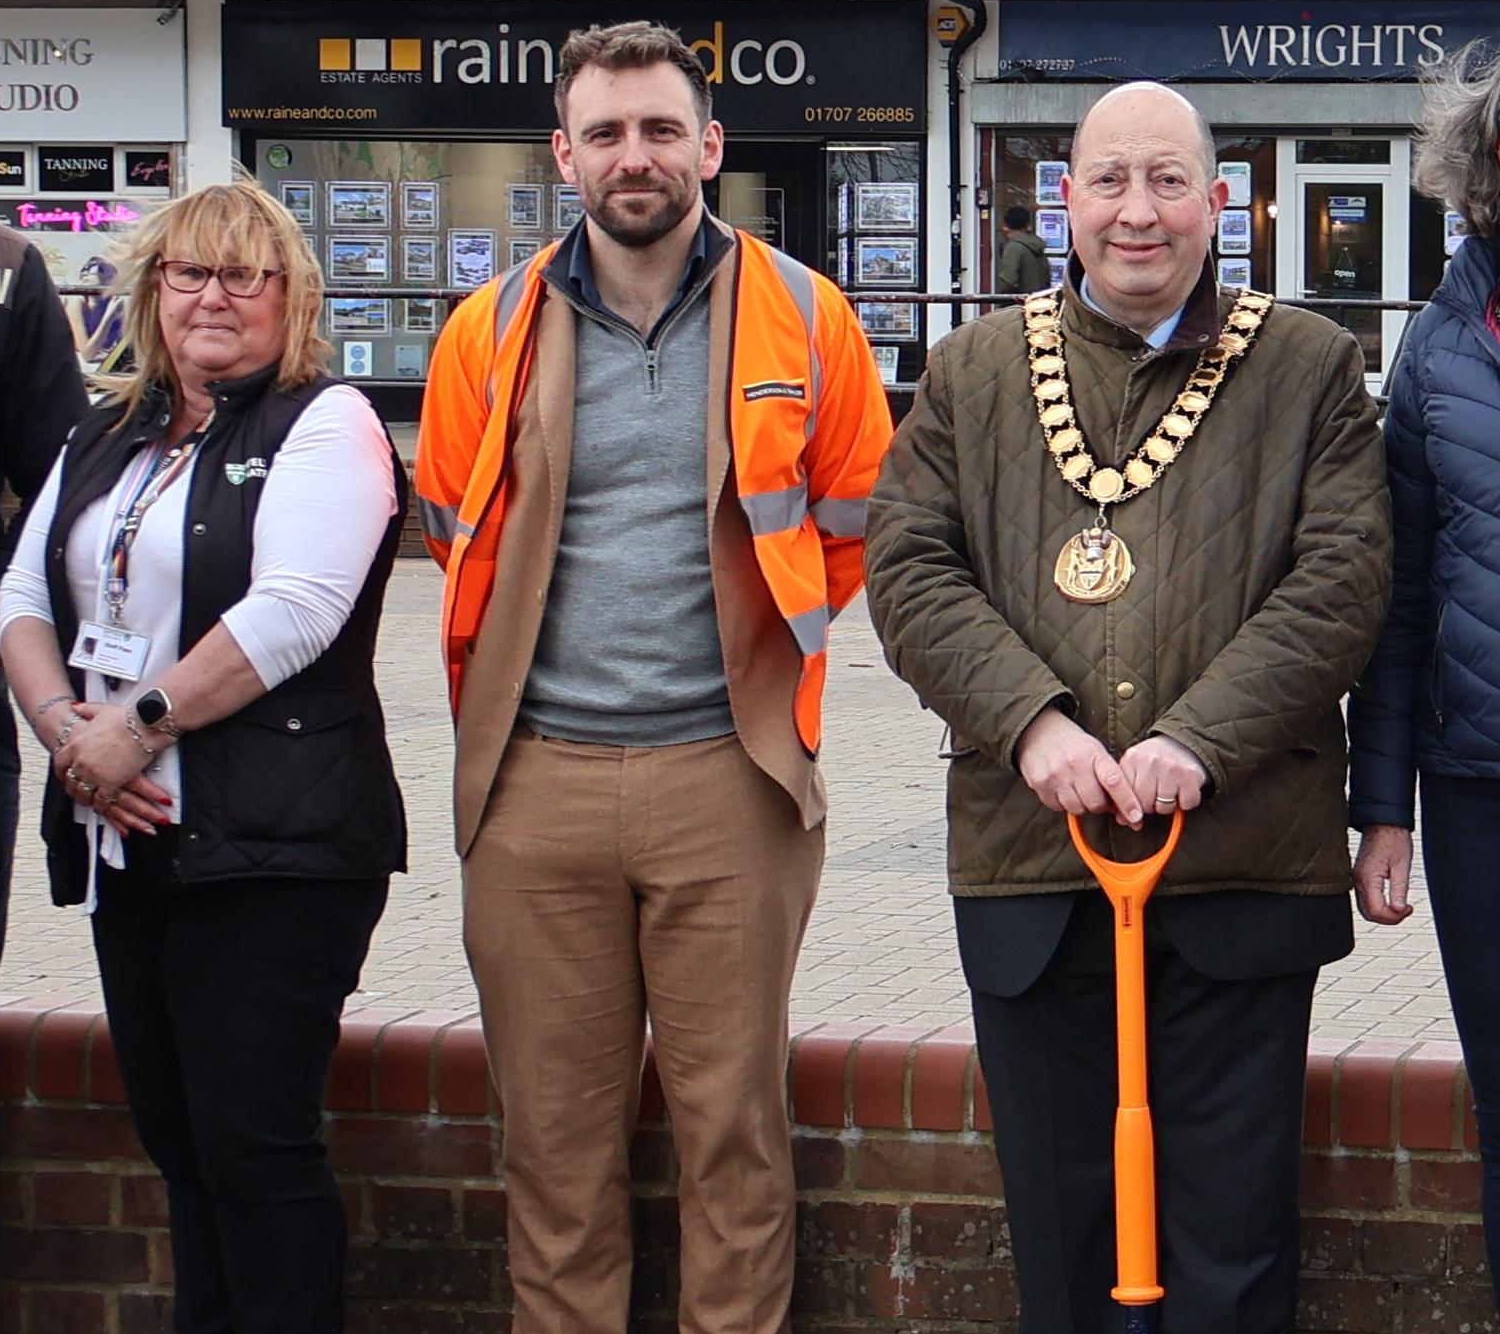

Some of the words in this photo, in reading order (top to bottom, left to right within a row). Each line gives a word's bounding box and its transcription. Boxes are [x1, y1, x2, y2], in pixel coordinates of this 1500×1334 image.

[938, 20, 957, 31] ADT
[1218, 24, 1445, 67] WRIGHTS
[431, 21, 807, 86] raindco
[321, 73, 366, 84] ESTATE
[372, 73, 422, 84] AGENTS
[228, 105, 378, 120] www.raineandco.com
[805, 107, 853, 122] 01707
[857, 107, 915, 122] 266885
[44, 158, 109, 170] TANNING
[16, 202, 82, 232] Tanning
[85, 201, 139, 226] Studio
[1334, 269, 1356, 278] open
